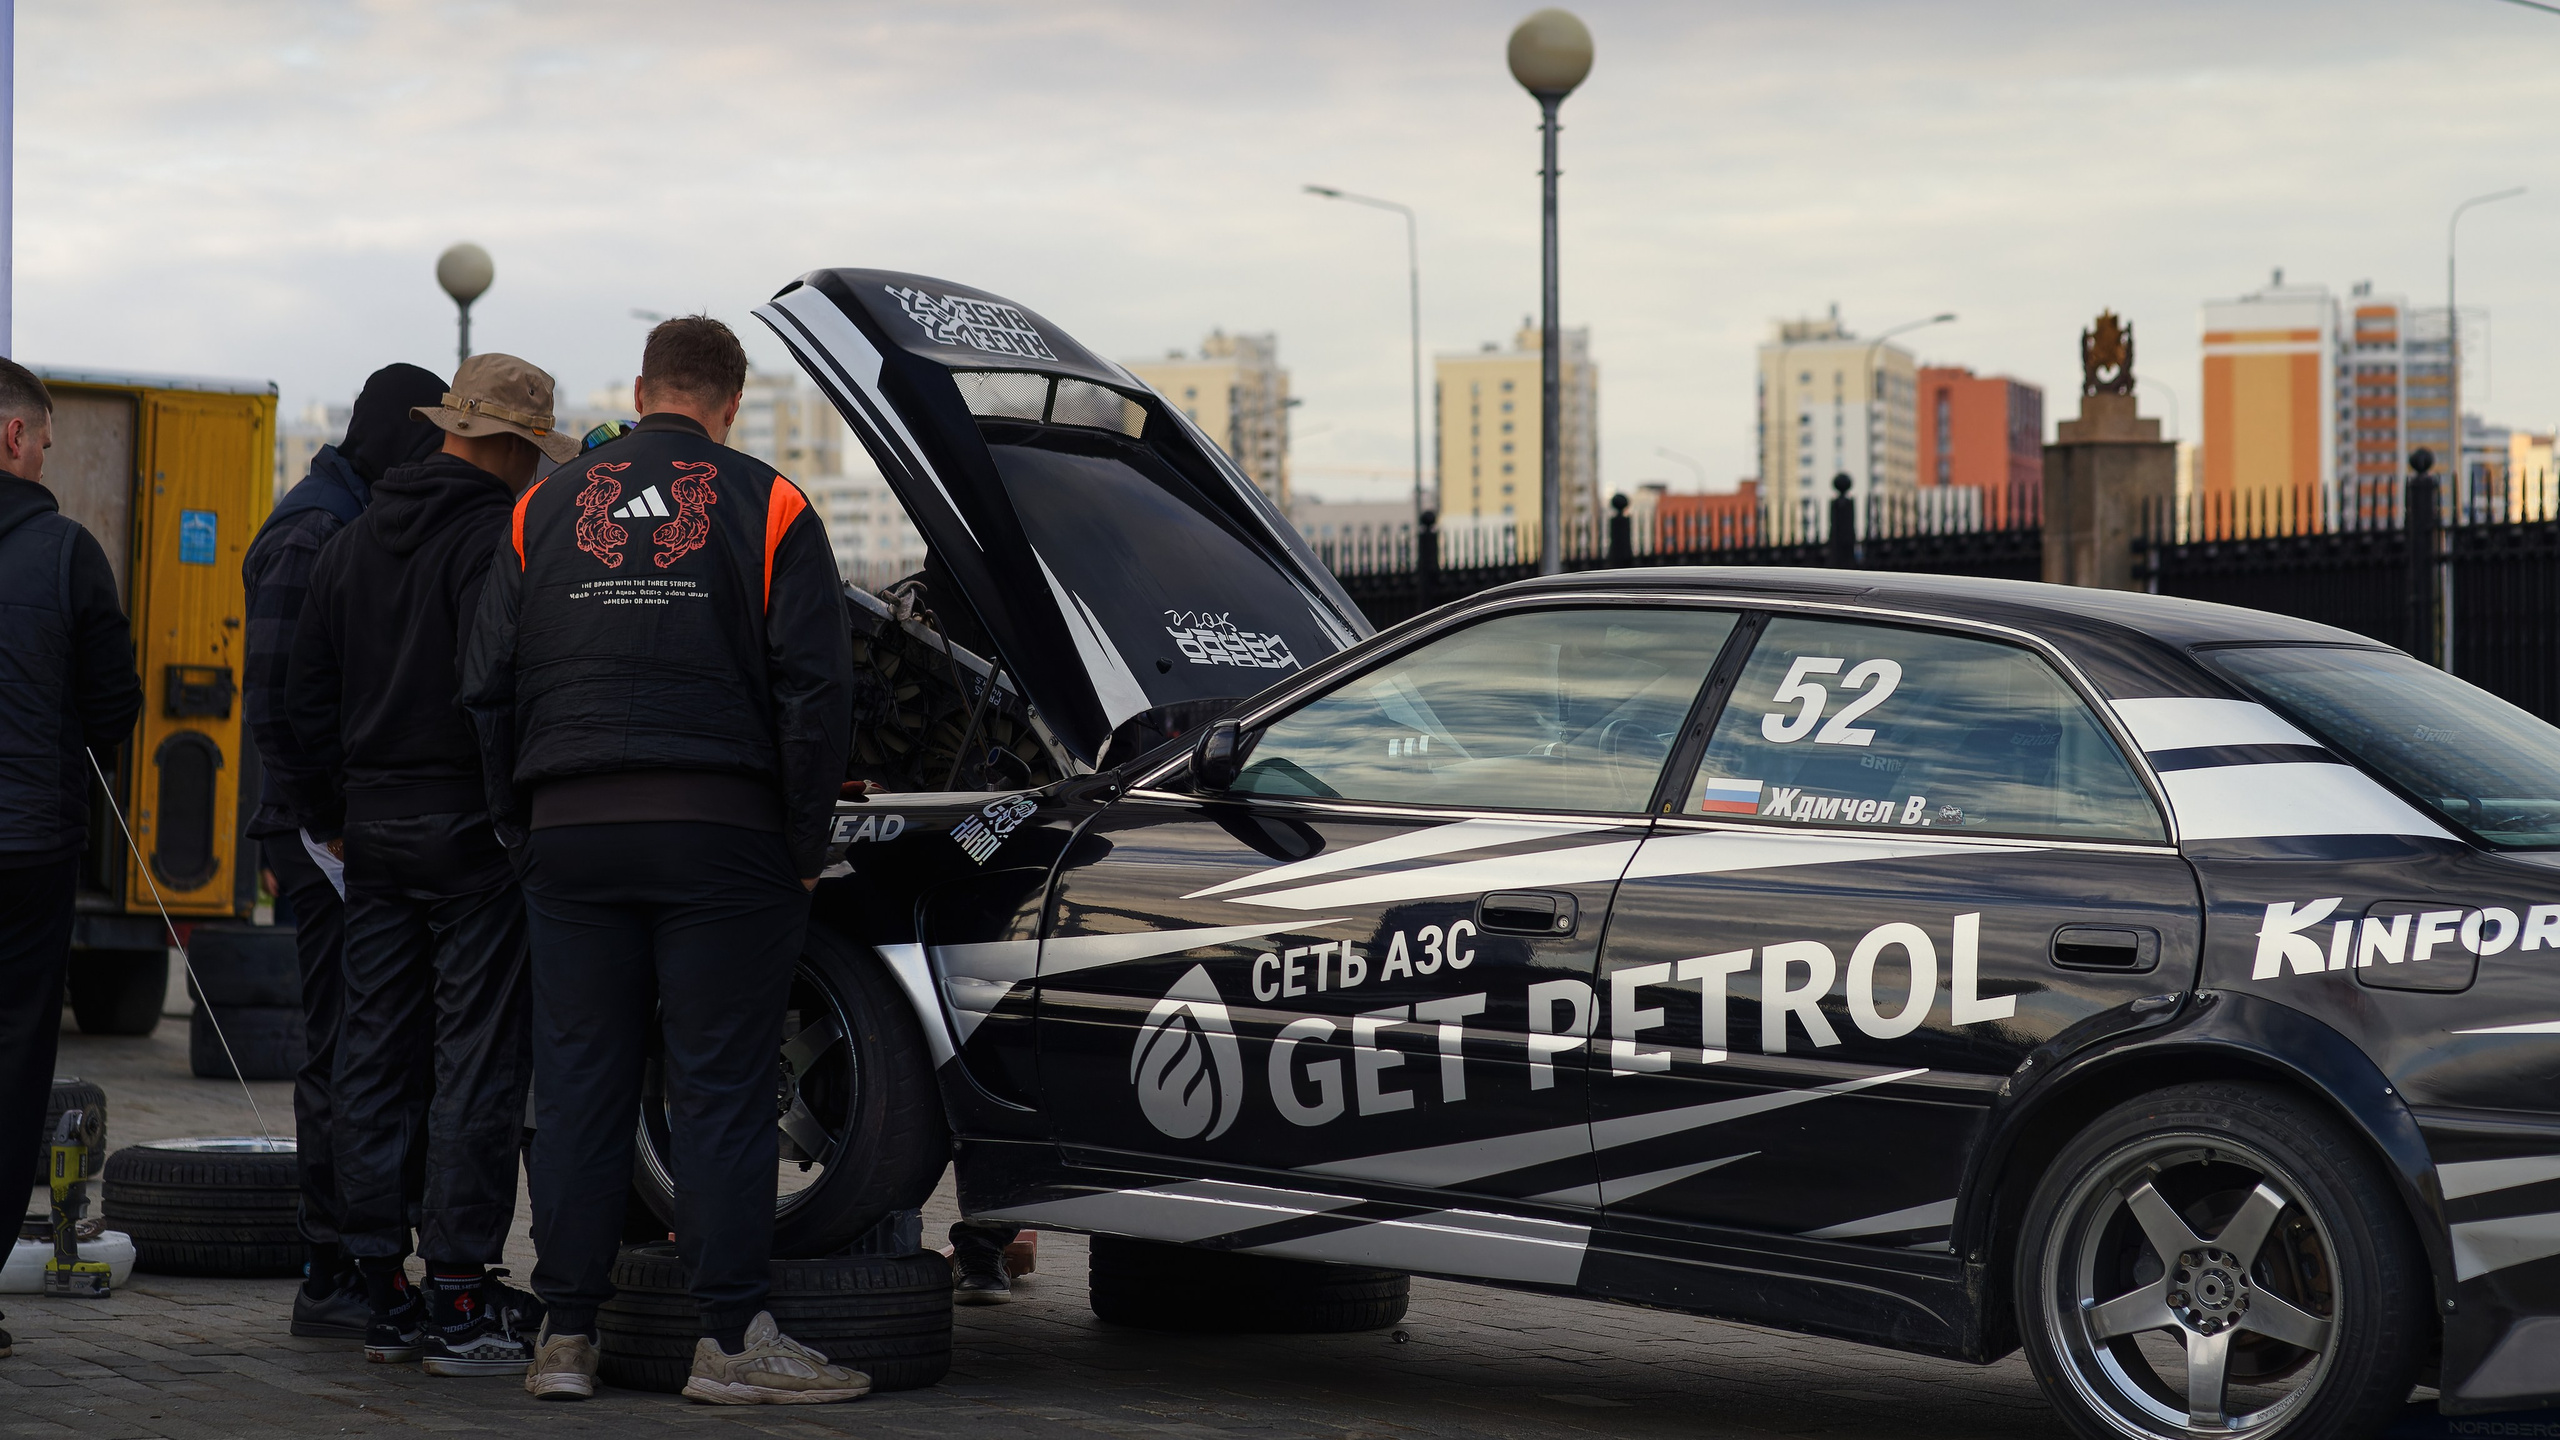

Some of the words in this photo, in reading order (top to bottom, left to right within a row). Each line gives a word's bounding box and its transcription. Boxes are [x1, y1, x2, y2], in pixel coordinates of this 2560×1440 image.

[594, 580, 614, 588] BRAND
[669, 580, 697, 588] STRIPES
[1761, 656, 1903, 747] 52
[829, 814, 905, 843] EAD
[1763, 787, 1895, 823] Ждмчел
[1899, 795, 1931, 826] В.
[950, 814, 1002, 866] HARD!
[1252, 942, 1366, 1002] СЕТЬ
[1380, 920, 1477, 982] АЗС
[1268, 992, 1488, 1126] GET
[1529, 912, 2017, 1090] PETROL
